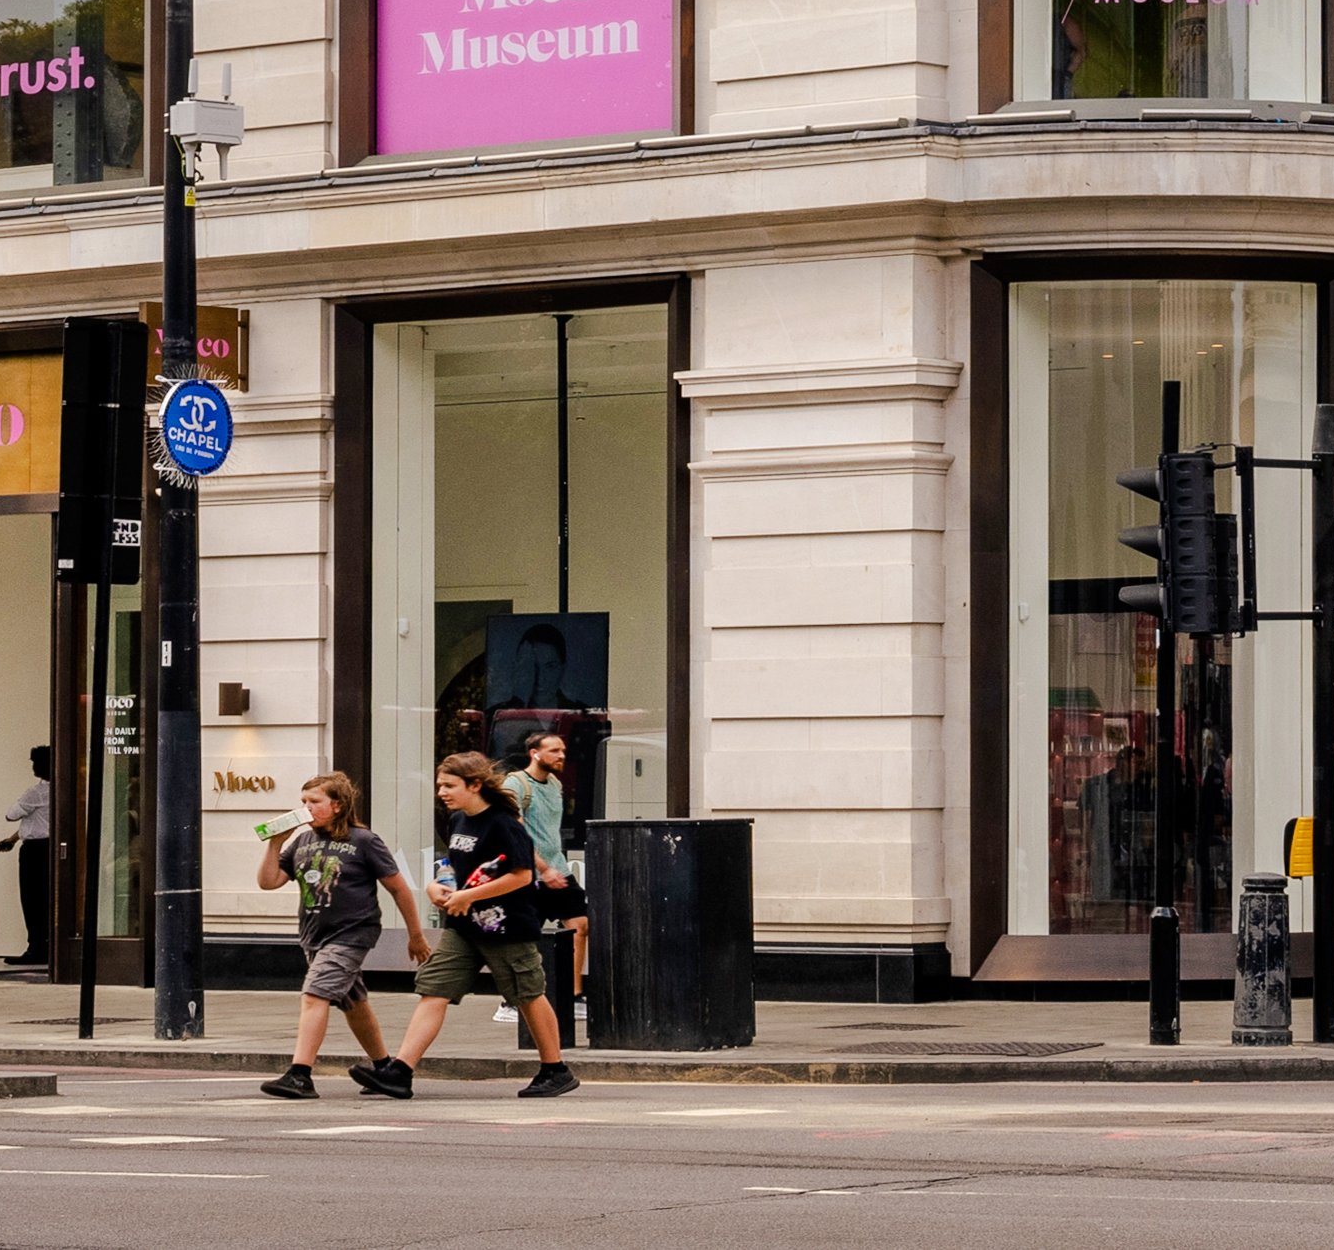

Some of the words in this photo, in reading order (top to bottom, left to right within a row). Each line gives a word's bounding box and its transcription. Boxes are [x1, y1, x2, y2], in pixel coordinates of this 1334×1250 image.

[417, 19, 641, 75] Museum
[168, 427, 224, 452] CHAPEL
[213, 771, 275, 793] Moco
